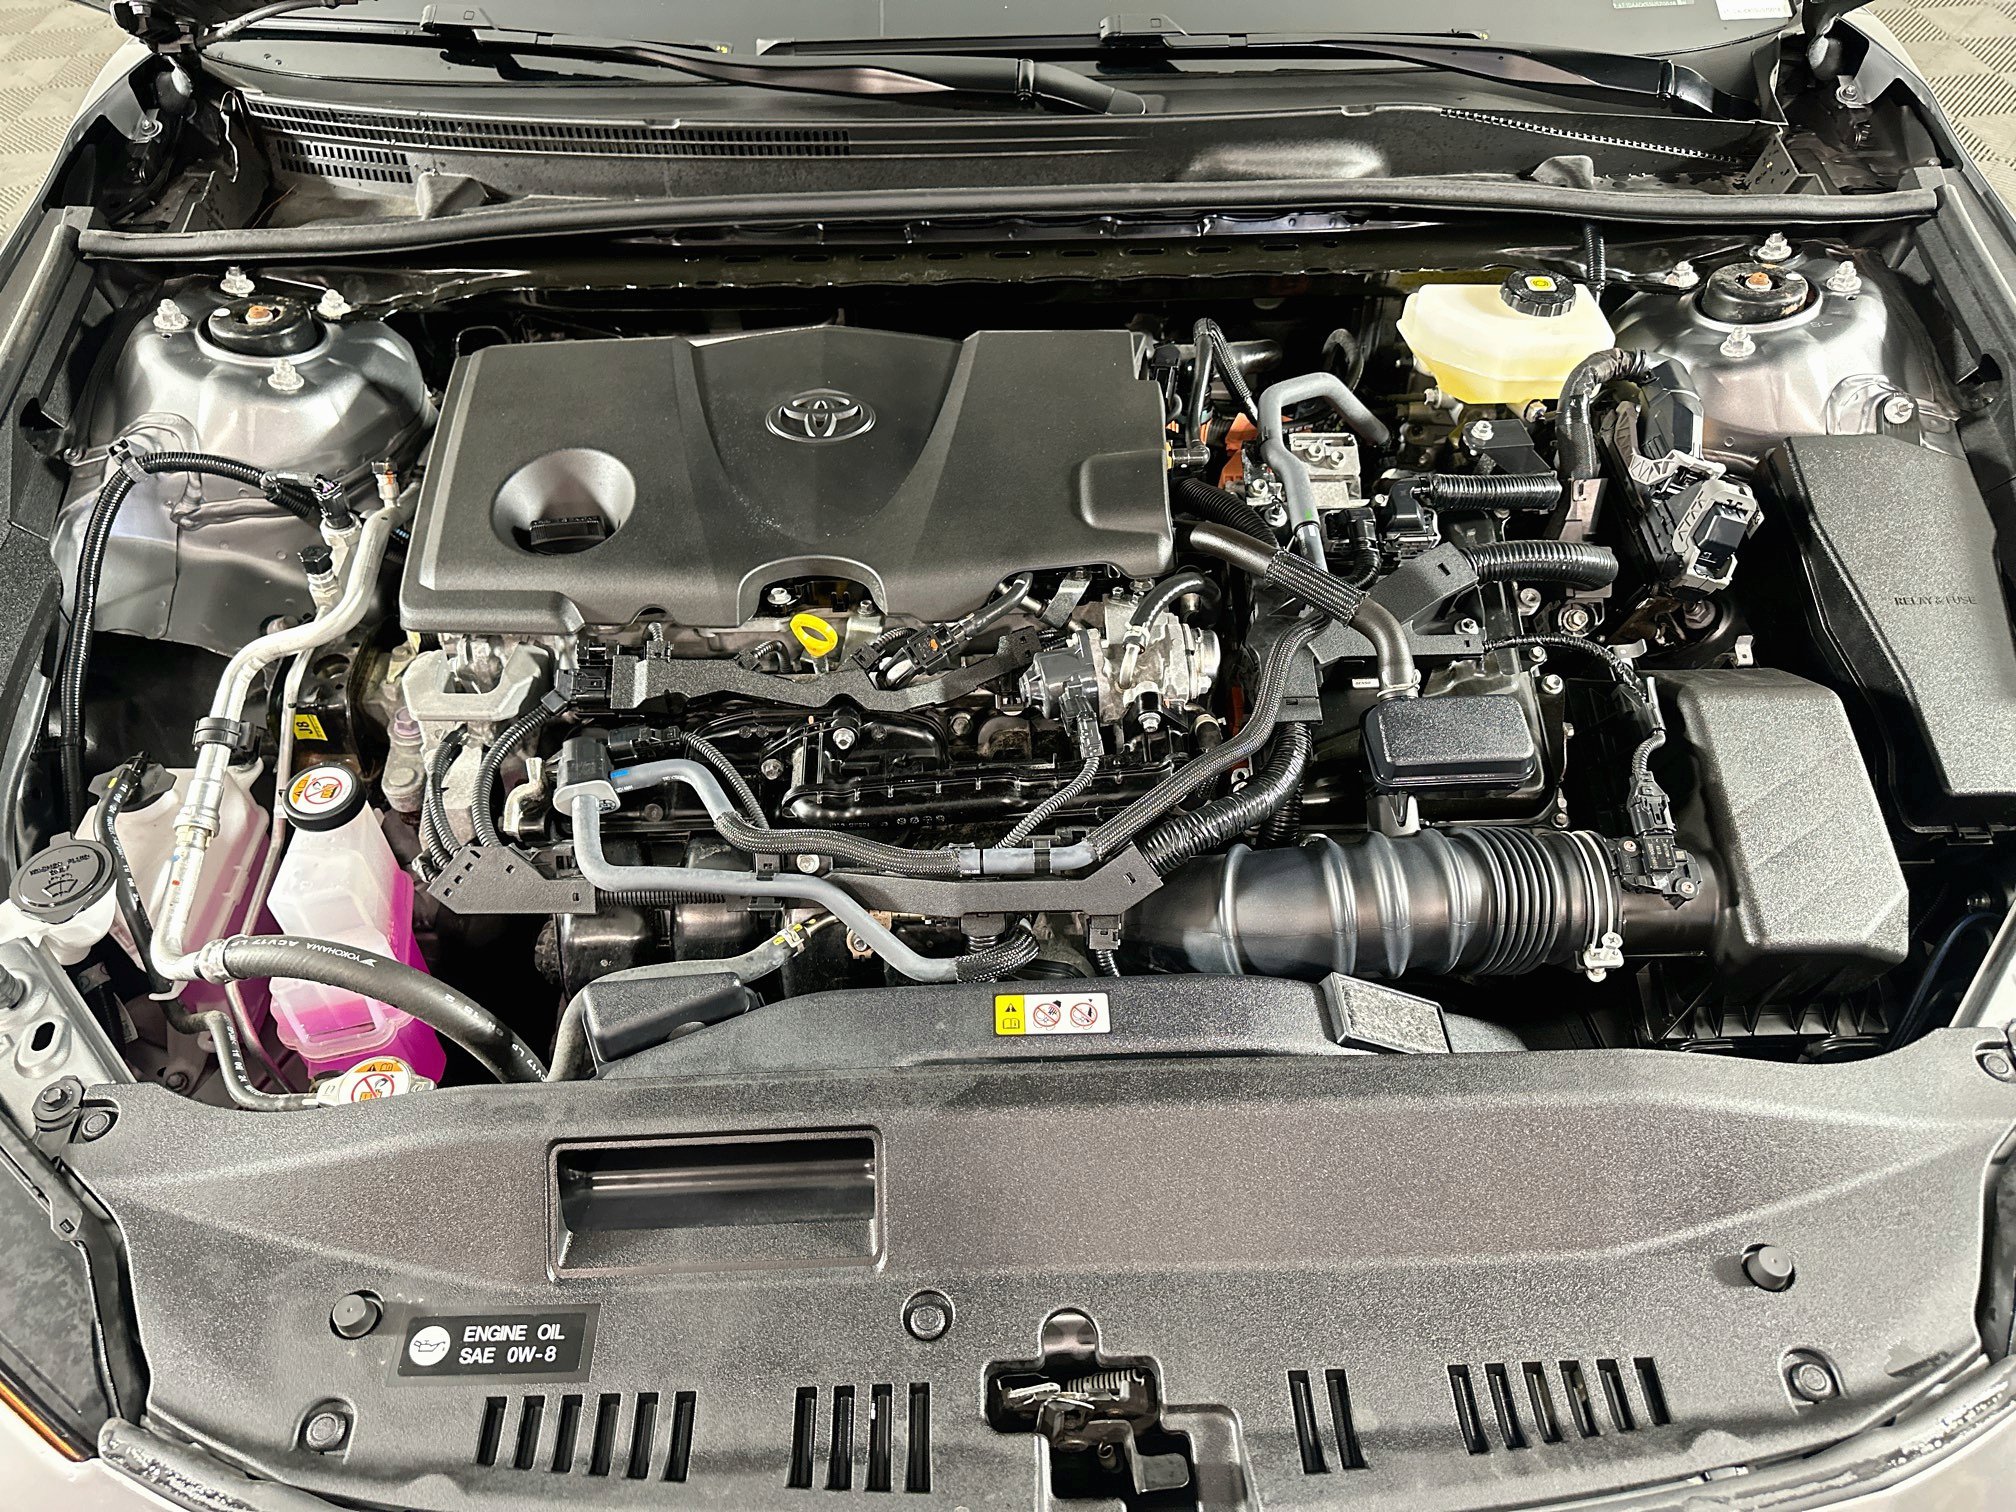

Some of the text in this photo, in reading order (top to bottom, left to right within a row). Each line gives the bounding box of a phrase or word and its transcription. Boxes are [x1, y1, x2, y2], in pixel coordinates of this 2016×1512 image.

[1894, 596, 1932, 606] RELAY
[1945, 595, 1978, 605] FUSE
[296, 721, 313, 734] J8
[306, 942, 361, 962] YOKOHAMA
[463, 1323, 565, 1342] ENGINE OIL
[458, 1345, 557, 1364] SAE 0W-8
